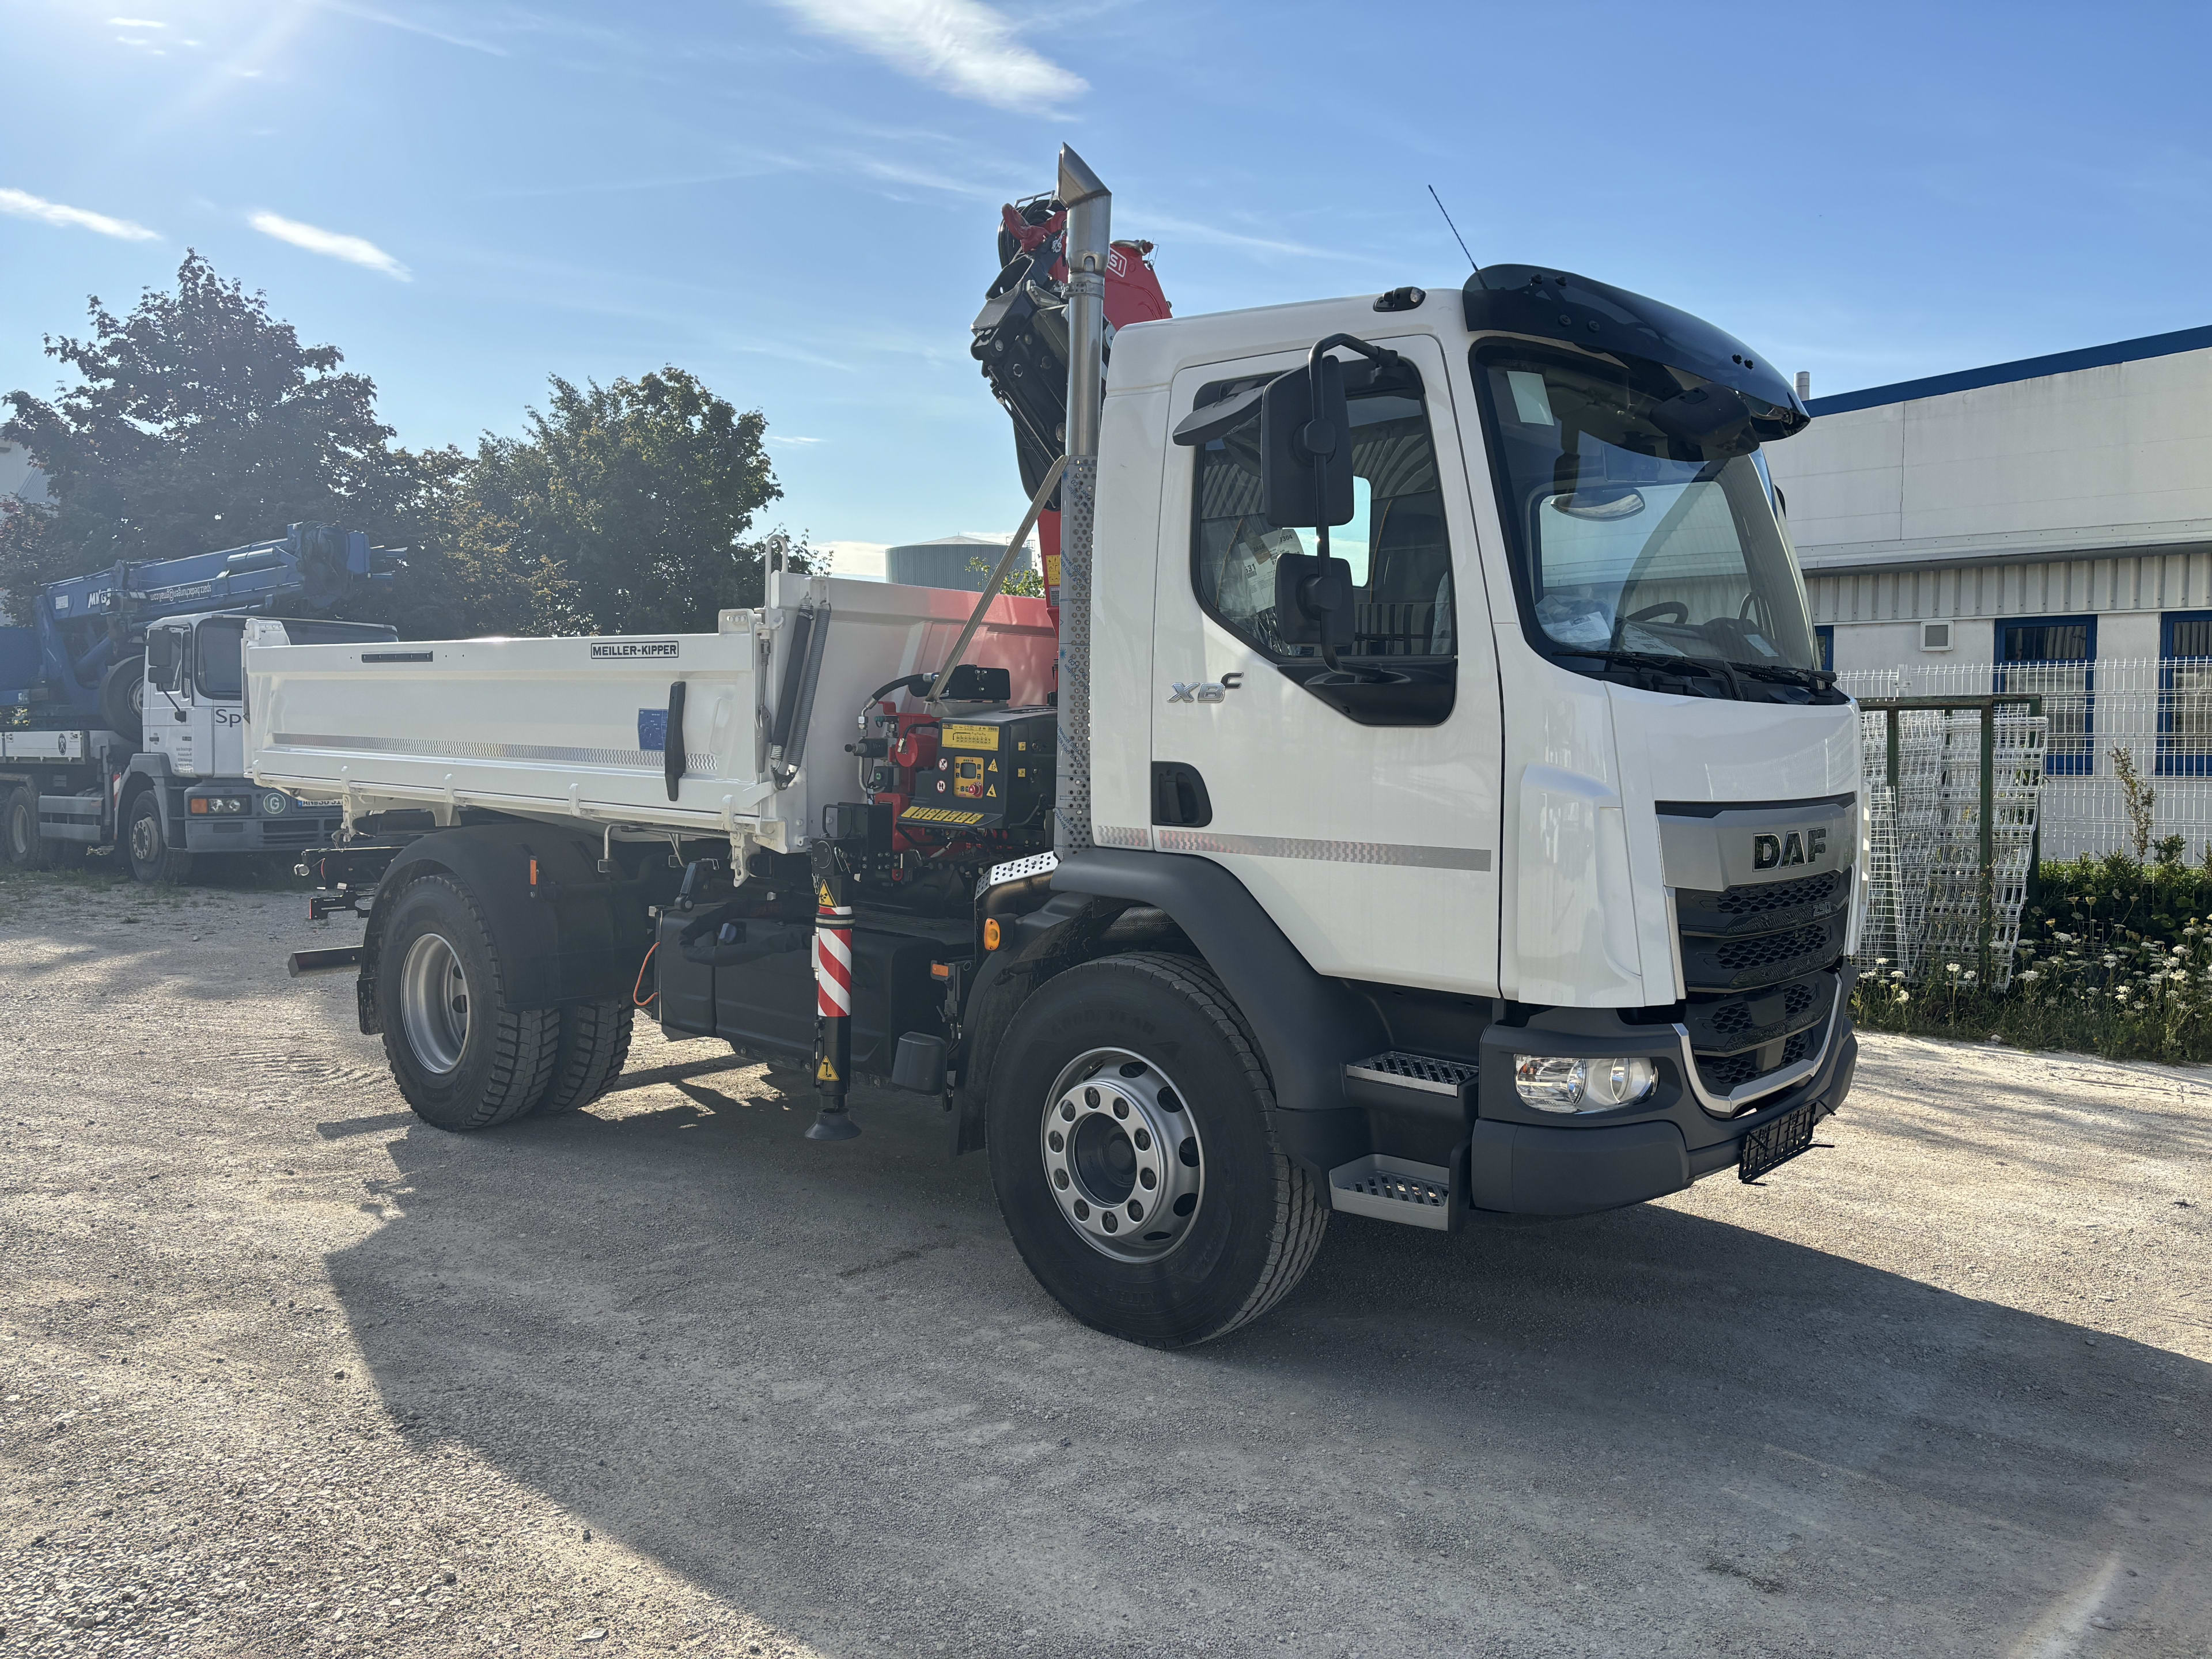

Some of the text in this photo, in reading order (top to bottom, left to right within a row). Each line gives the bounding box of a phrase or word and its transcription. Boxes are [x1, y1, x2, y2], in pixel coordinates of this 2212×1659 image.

[592, 645, 677, 656] MEILLER-KIPPER
[270, 797, 280, 810] G
[1752, 827, 1827, 873] DAF
[1813, 902, 1832, 916] 290
